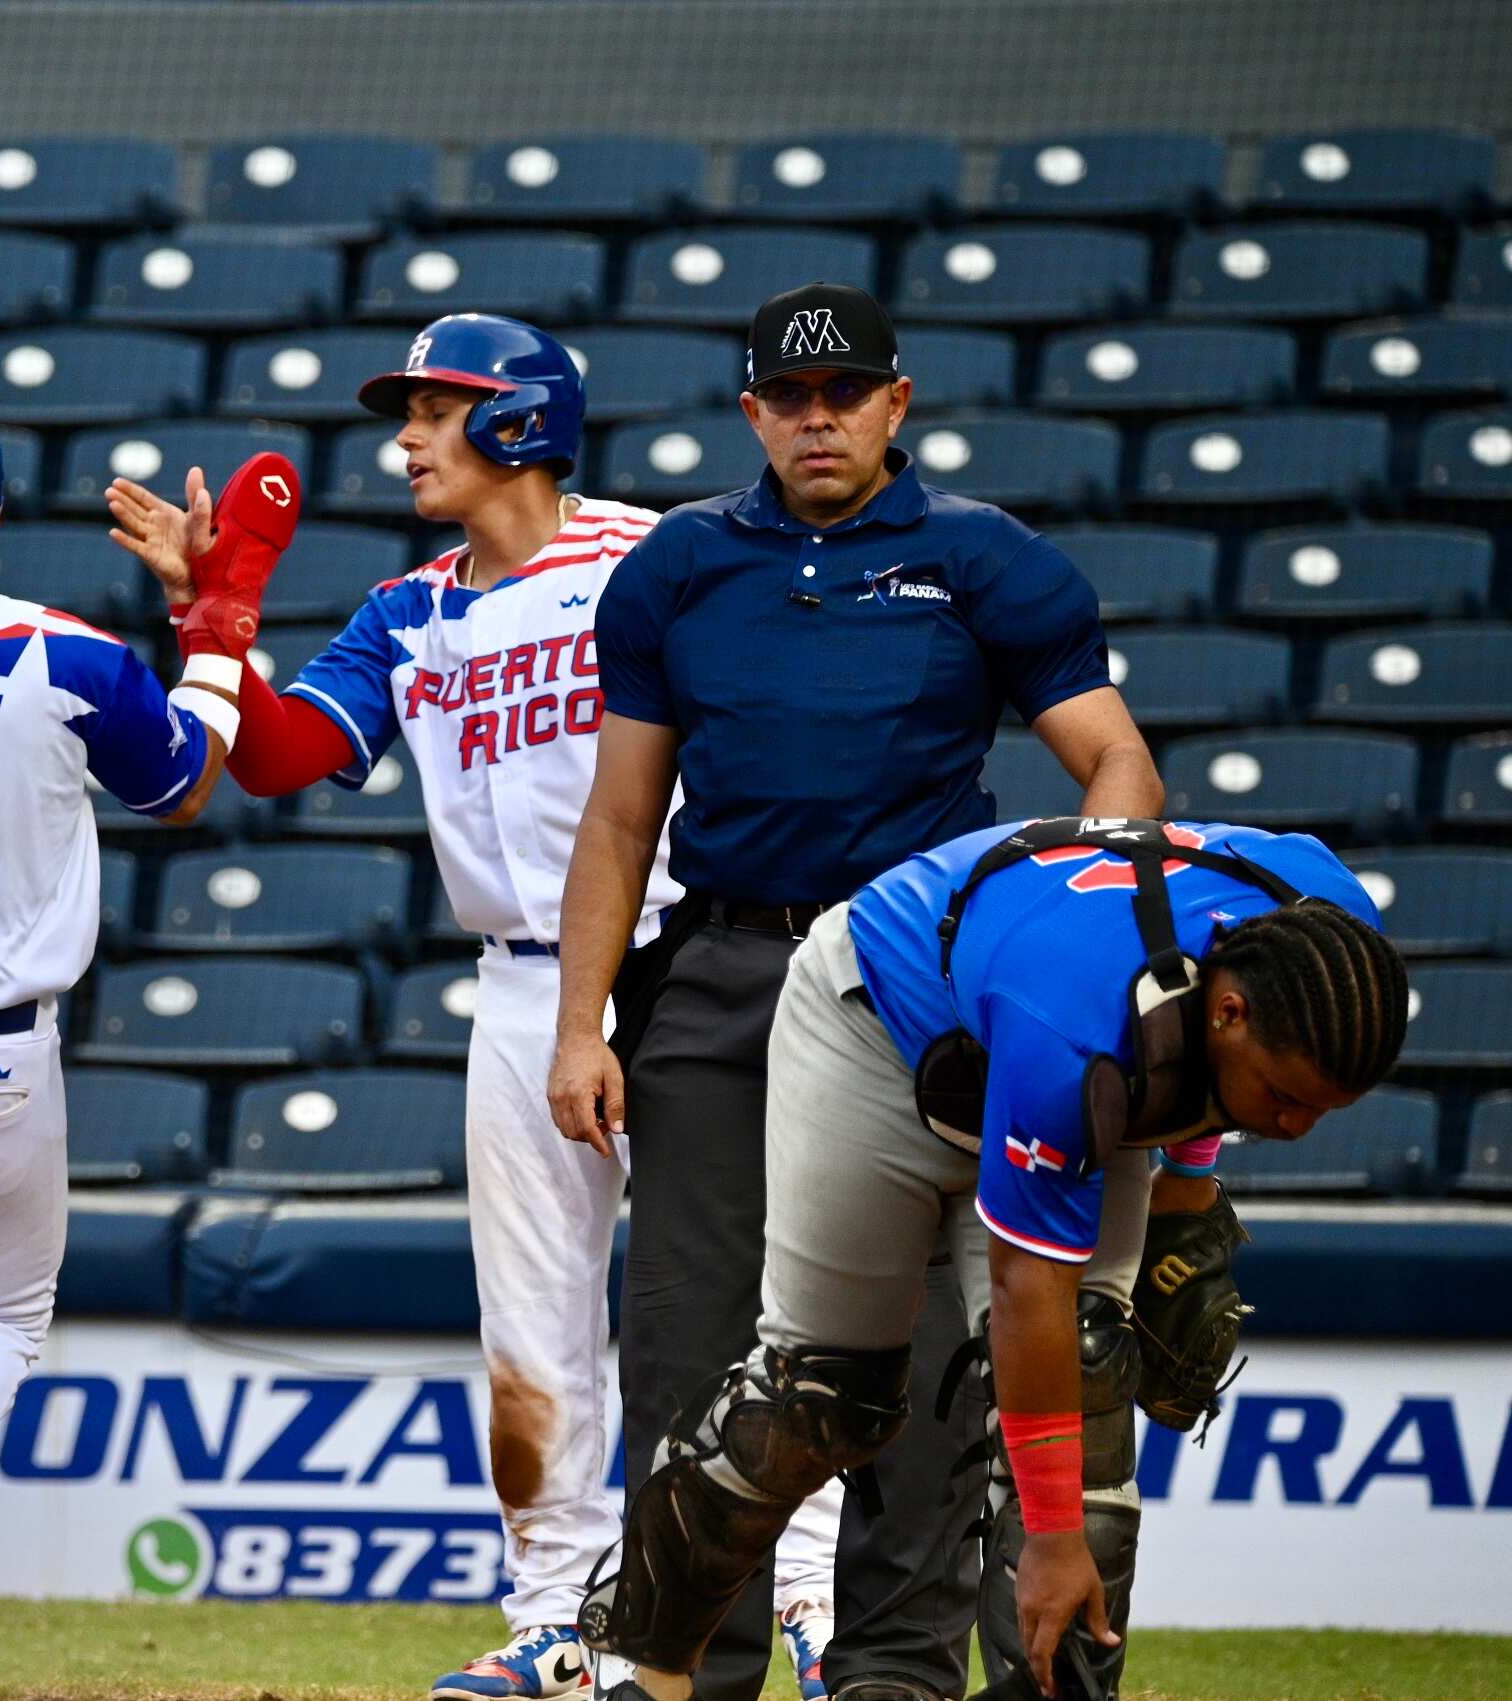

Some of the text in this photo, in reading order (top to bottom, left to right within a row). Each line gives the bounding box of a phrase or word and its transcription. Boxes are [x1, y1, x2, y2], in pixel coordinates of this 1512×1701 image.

[781, 308, 852, 360] M
[405, 629, 601, 720] PUERTO
[459, 686, 606, 772] RICO
[1133, 1391, 1512, 1511] TRA
[215, 1525, 512, 1599] 8373
